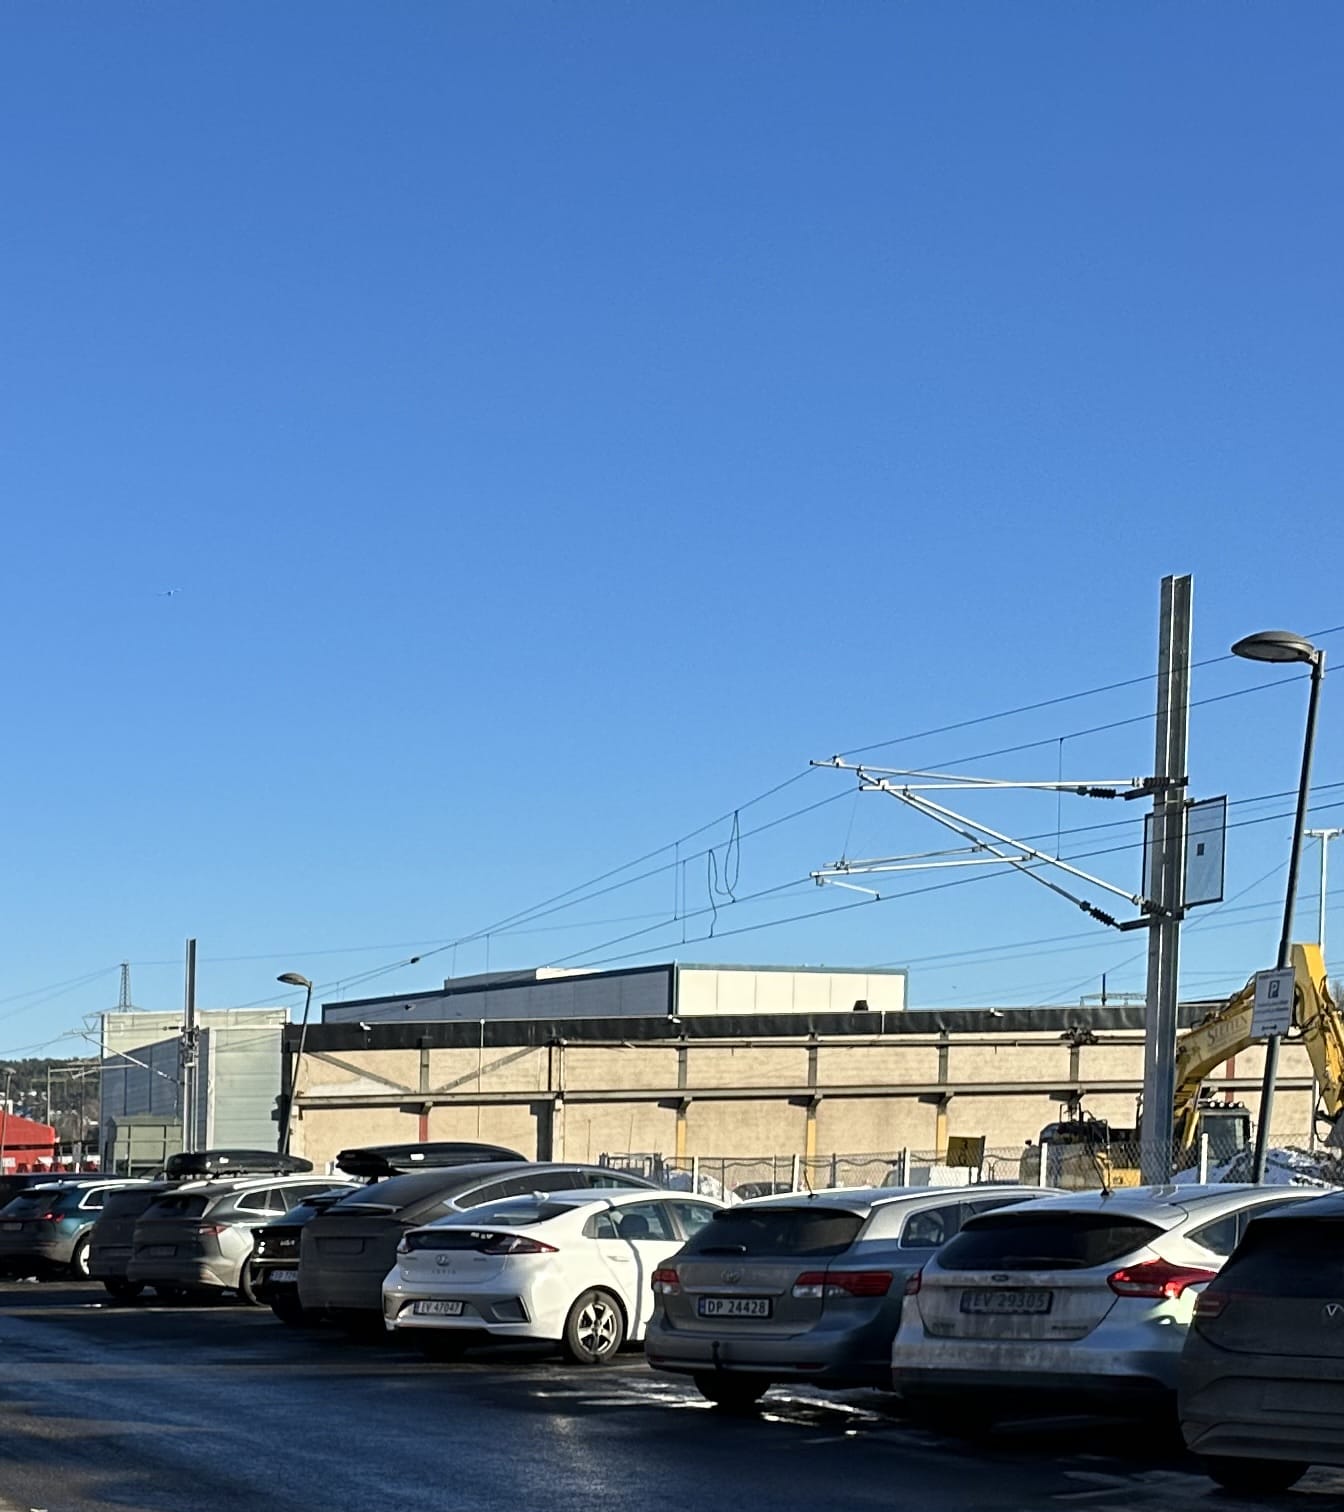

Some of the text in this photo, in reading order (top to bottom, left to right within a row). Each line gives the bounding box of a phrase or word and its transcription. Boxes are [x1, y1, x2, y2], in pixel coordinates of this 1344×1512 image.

[707, 1300, 766, 1314] DP 24428
[973, 1294, 992, 1307] EV
[434, 1302, 461, 1314] 47047
